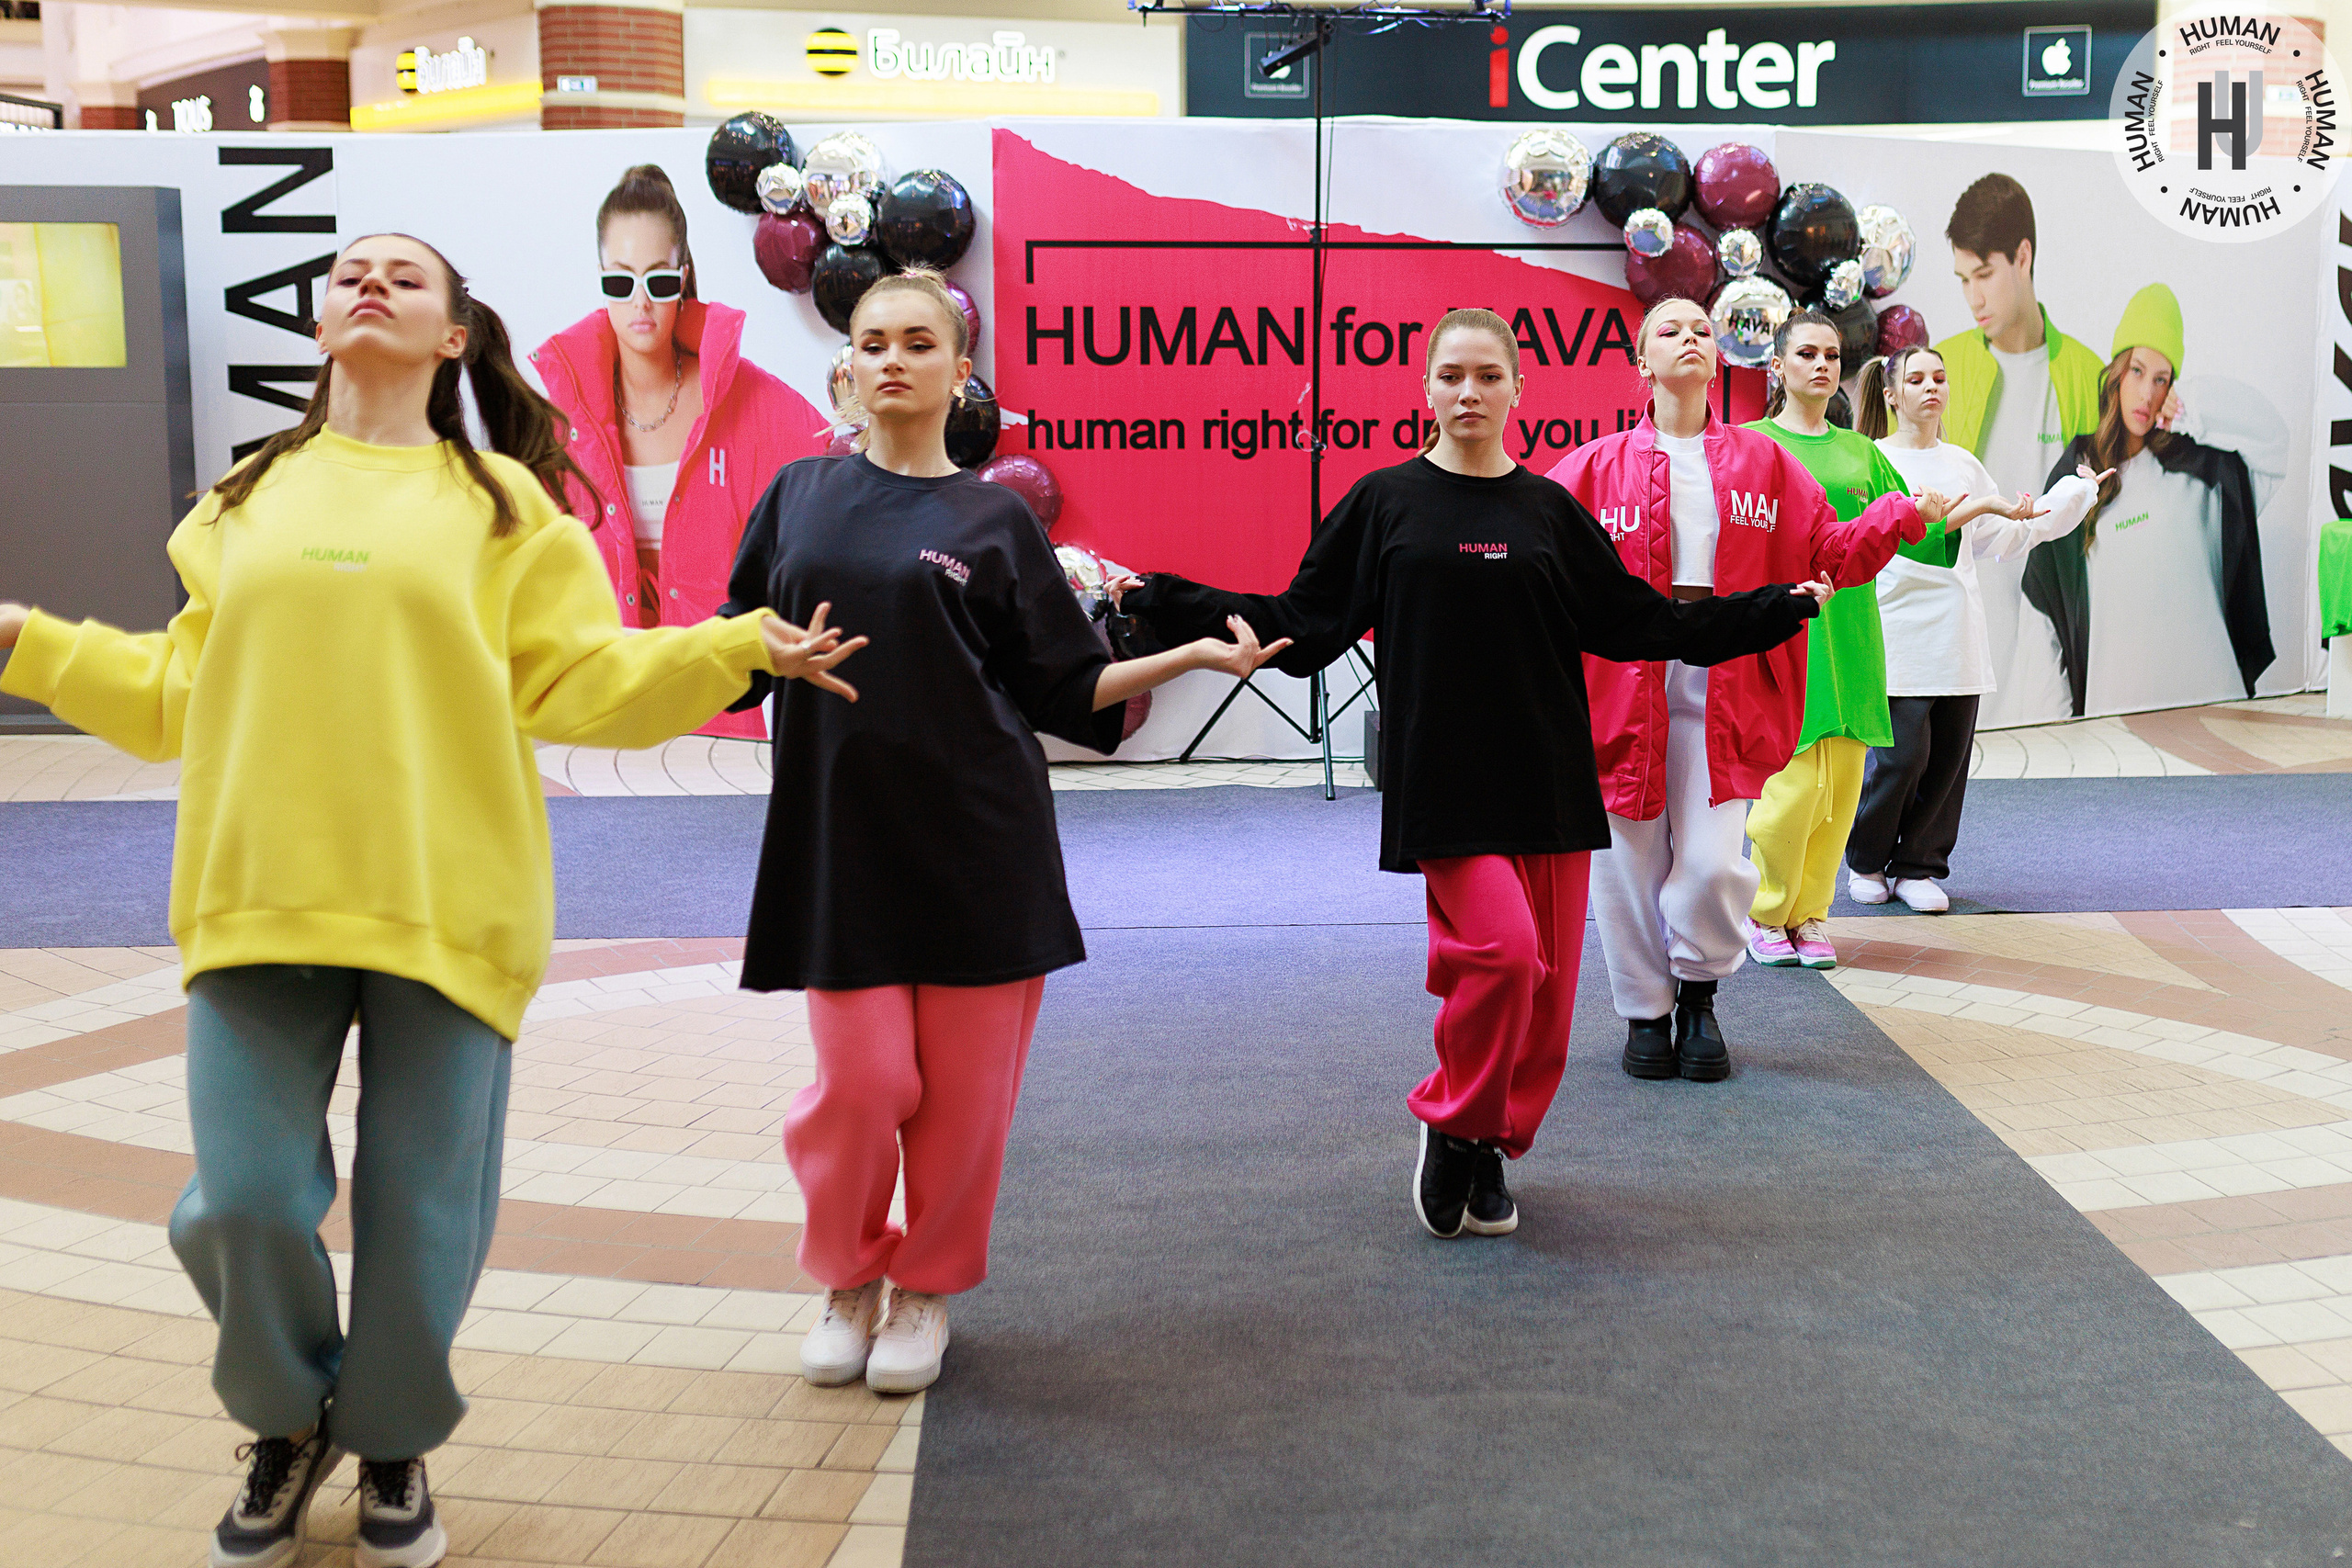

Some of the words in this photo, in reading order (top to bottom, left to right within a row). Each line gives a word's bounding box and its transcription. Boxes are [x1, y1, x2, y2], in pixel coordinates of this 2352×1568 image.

[867, 28, 1056, 84] Билайн
[1489, 24, 1837, 110] iCenter
[1026, 306, 1305, 366] HUMAN
[1330, 306, 1424, 367] for
[1447, 308, 1651, 366] AVA
[1027, 409, 1185, 449] human
[1204, 409, 1305, 459] right
[1319, 409, 1380, 449] for
[1518, 420, 1599, 460] you
[709, 446, 725, 487] H
[1600, 505, 1640, 533] HU
[1730, 514, 1749, 526] FEEL
[2115, 511, 2149, 532] HUMAN
[300, 547, 369, 563] HUMAN
[919, 548, 971, 580] HUMAN
[1459, 543, 1508, 553] HUMAN
